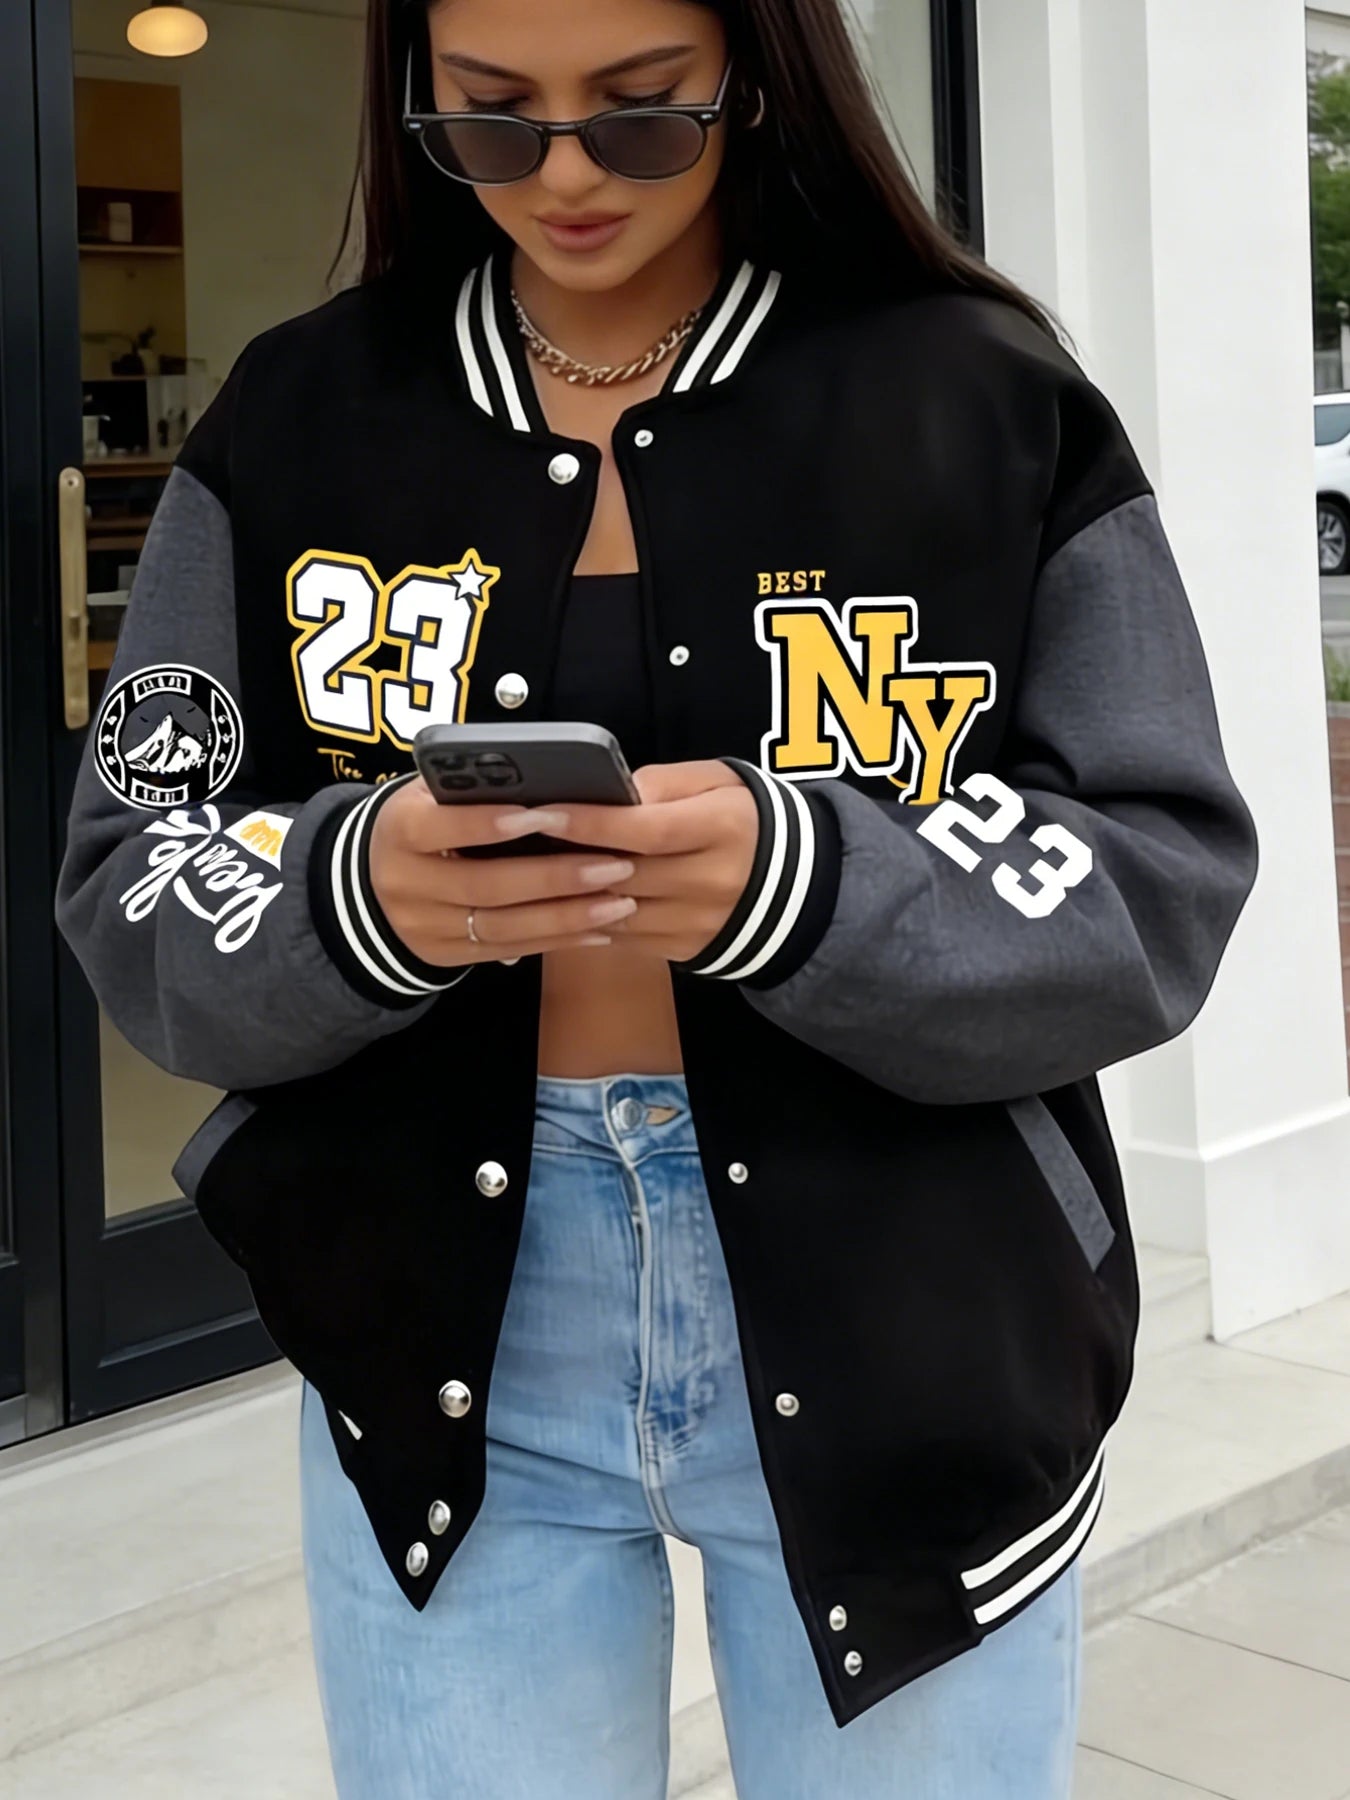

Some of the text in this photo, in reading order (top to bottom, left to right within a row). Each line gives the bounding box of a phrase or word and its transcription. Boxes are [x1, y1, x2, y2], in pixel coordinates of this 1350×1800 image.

[288, 549, 481, 751] 23
[757, 570, 826, 595] BEST
[755, 597, 996, 805] NY
[916, 773, 1093, 919] 23
